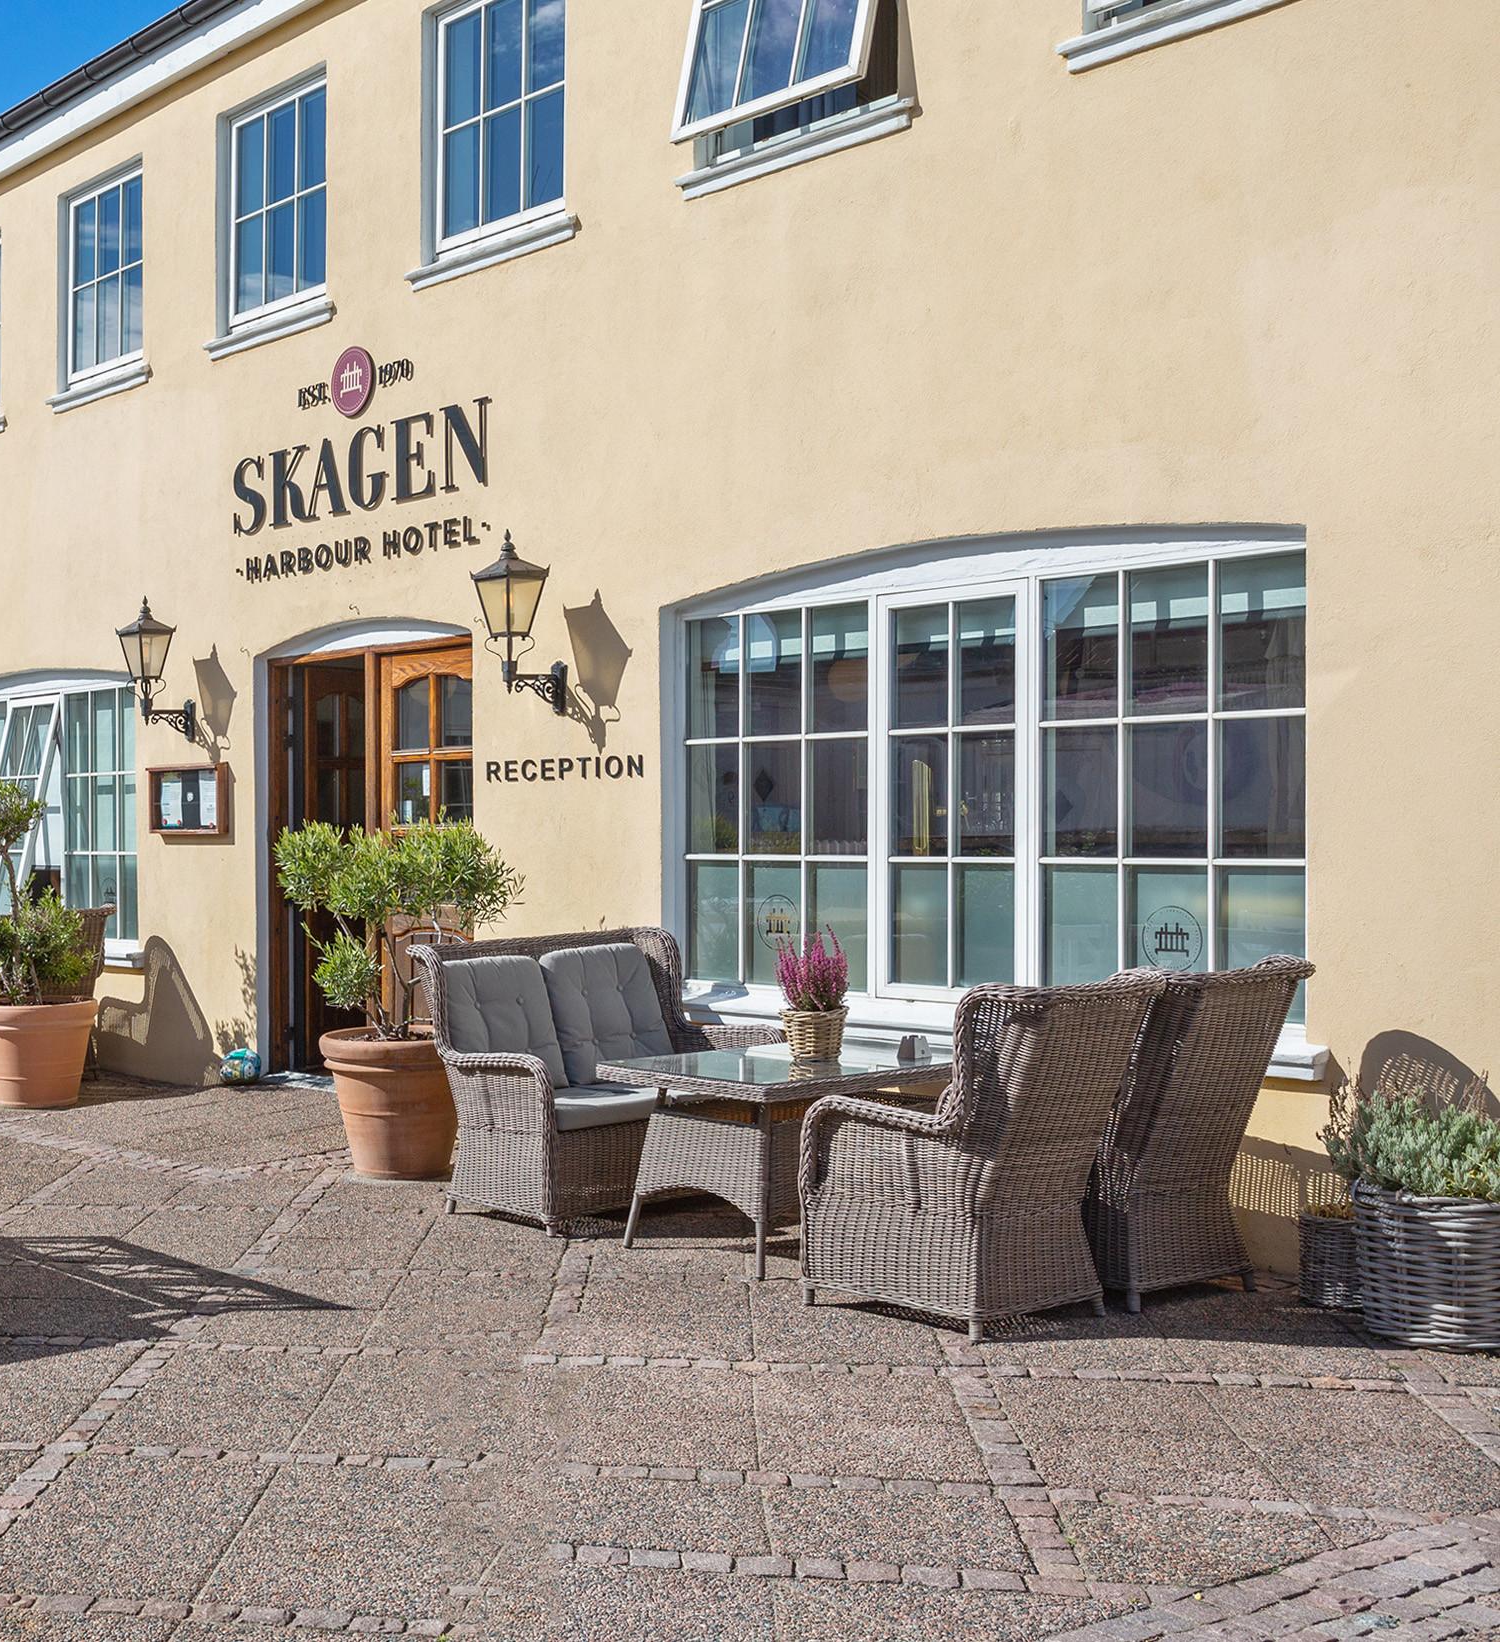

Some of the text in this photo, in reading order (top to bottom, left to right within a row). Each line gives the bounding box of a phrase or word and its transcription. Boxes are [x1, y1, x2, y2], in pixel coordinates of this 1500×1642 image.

[297, 359, 412, 409] EST. 1970
[233, 396, 491, 536] SKAGEN
[246, 516, 480, 582] HARBOUR HOTEL
[486, 754, 645, 784] RECEPTION
